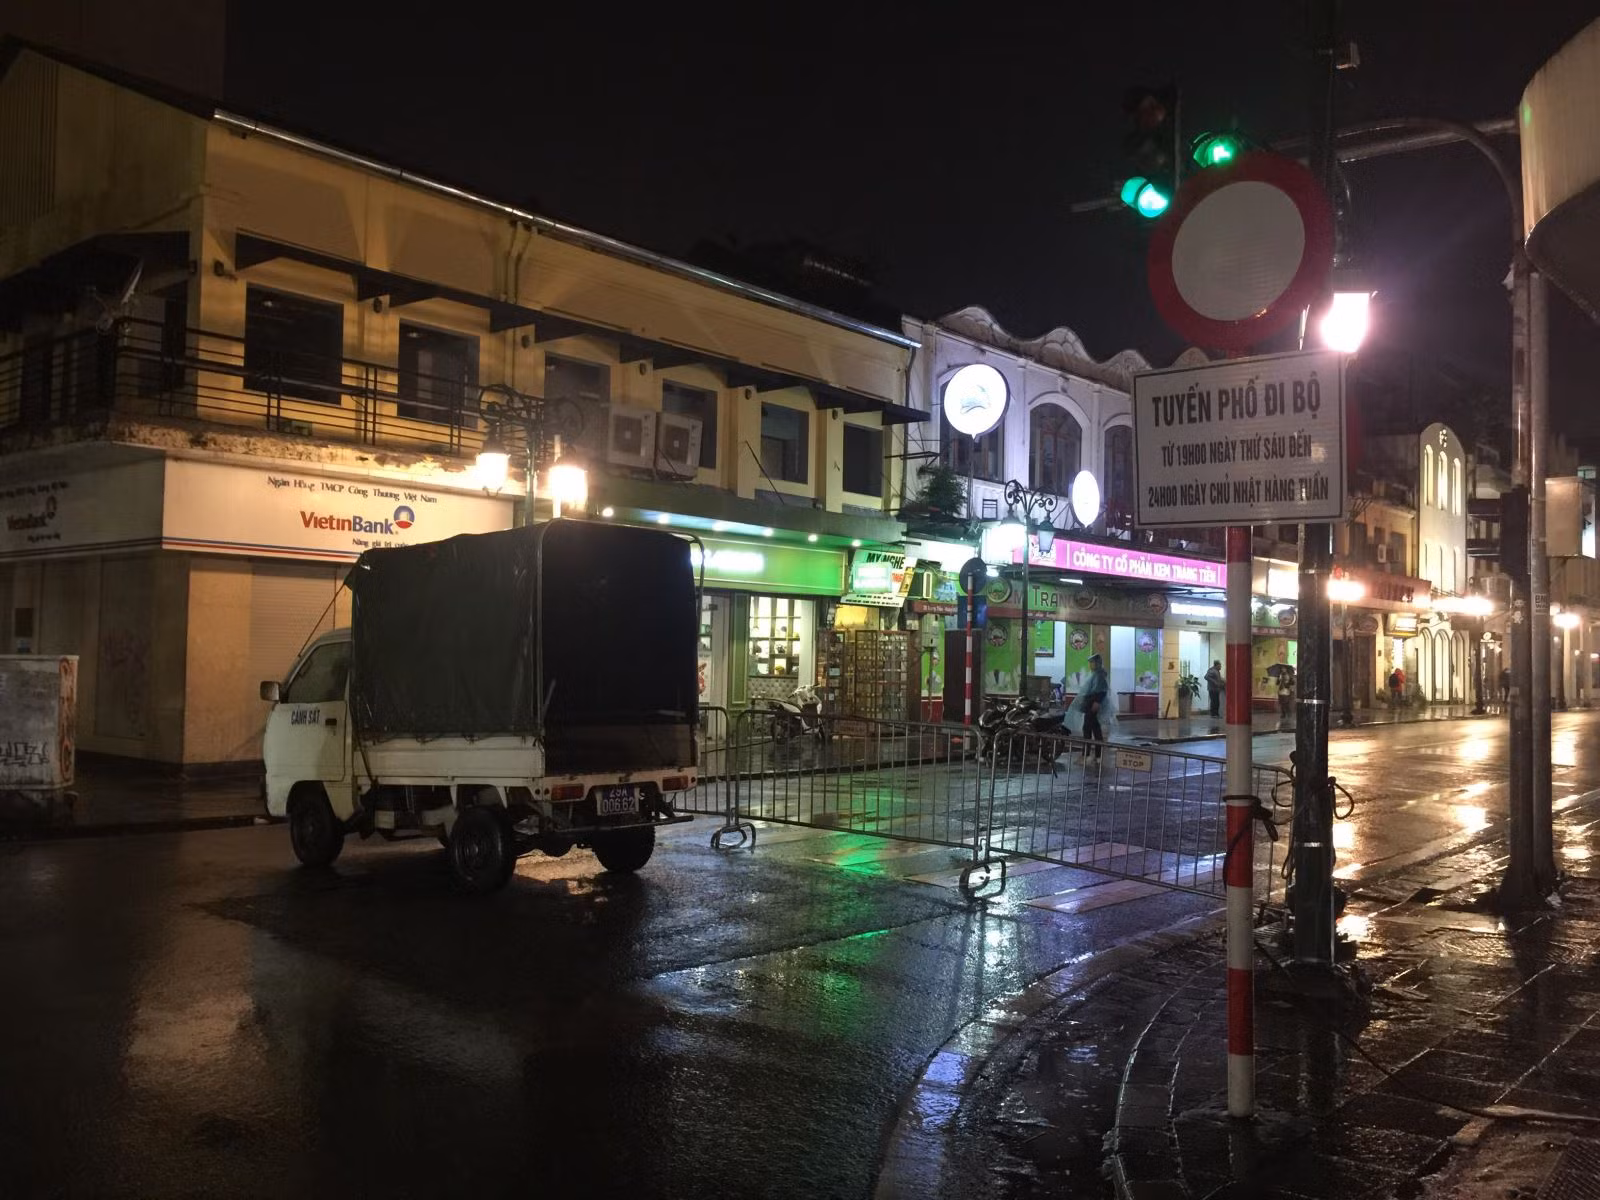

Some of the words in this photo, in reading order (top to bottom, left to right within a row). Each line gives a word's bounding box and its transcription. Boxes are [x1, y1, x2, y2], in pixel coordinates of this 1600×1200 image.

[1152, 382, 1211, 427] TUYẾN
[1218, 375, 1259, 421] PHỐ
[1264, 382, 1285, 416] ĐI
[1292, 371, 1321, 419] BỘ
[1161, 440, 1175, 467] TỪ
[1177, 442, 1206, 466] 19H00
[1209, 436, 1236, 464] NGÀY
[1239, 432, 1261, 461] THỨ
[1263, 432, 1285, 460] SÁU
[1289, 428, 1312, 458] ĐẾN
[321, 482, 344, 493] TMCP
[348, 486, 368, 498] Công
[420, 494, 437, 503] Nam
[1148, 484, 1178, 507] 24H00
[1180, 478, 1207, 506] NGÀY
[1209, 473, 1230, 504] CHỦ
[1233, 477, 1262, 507] NHẬT
[1264, 474, 1295, 502] HÀNG
[1298, 470, 1329, 502] TUẦN
[300, 510, 394, 535] VietinBank
[1073, 547, 1100, 569] CÔNG
[1101, 554, 1114, 570] TY
[1153, 562, 1171, 579] KEM
